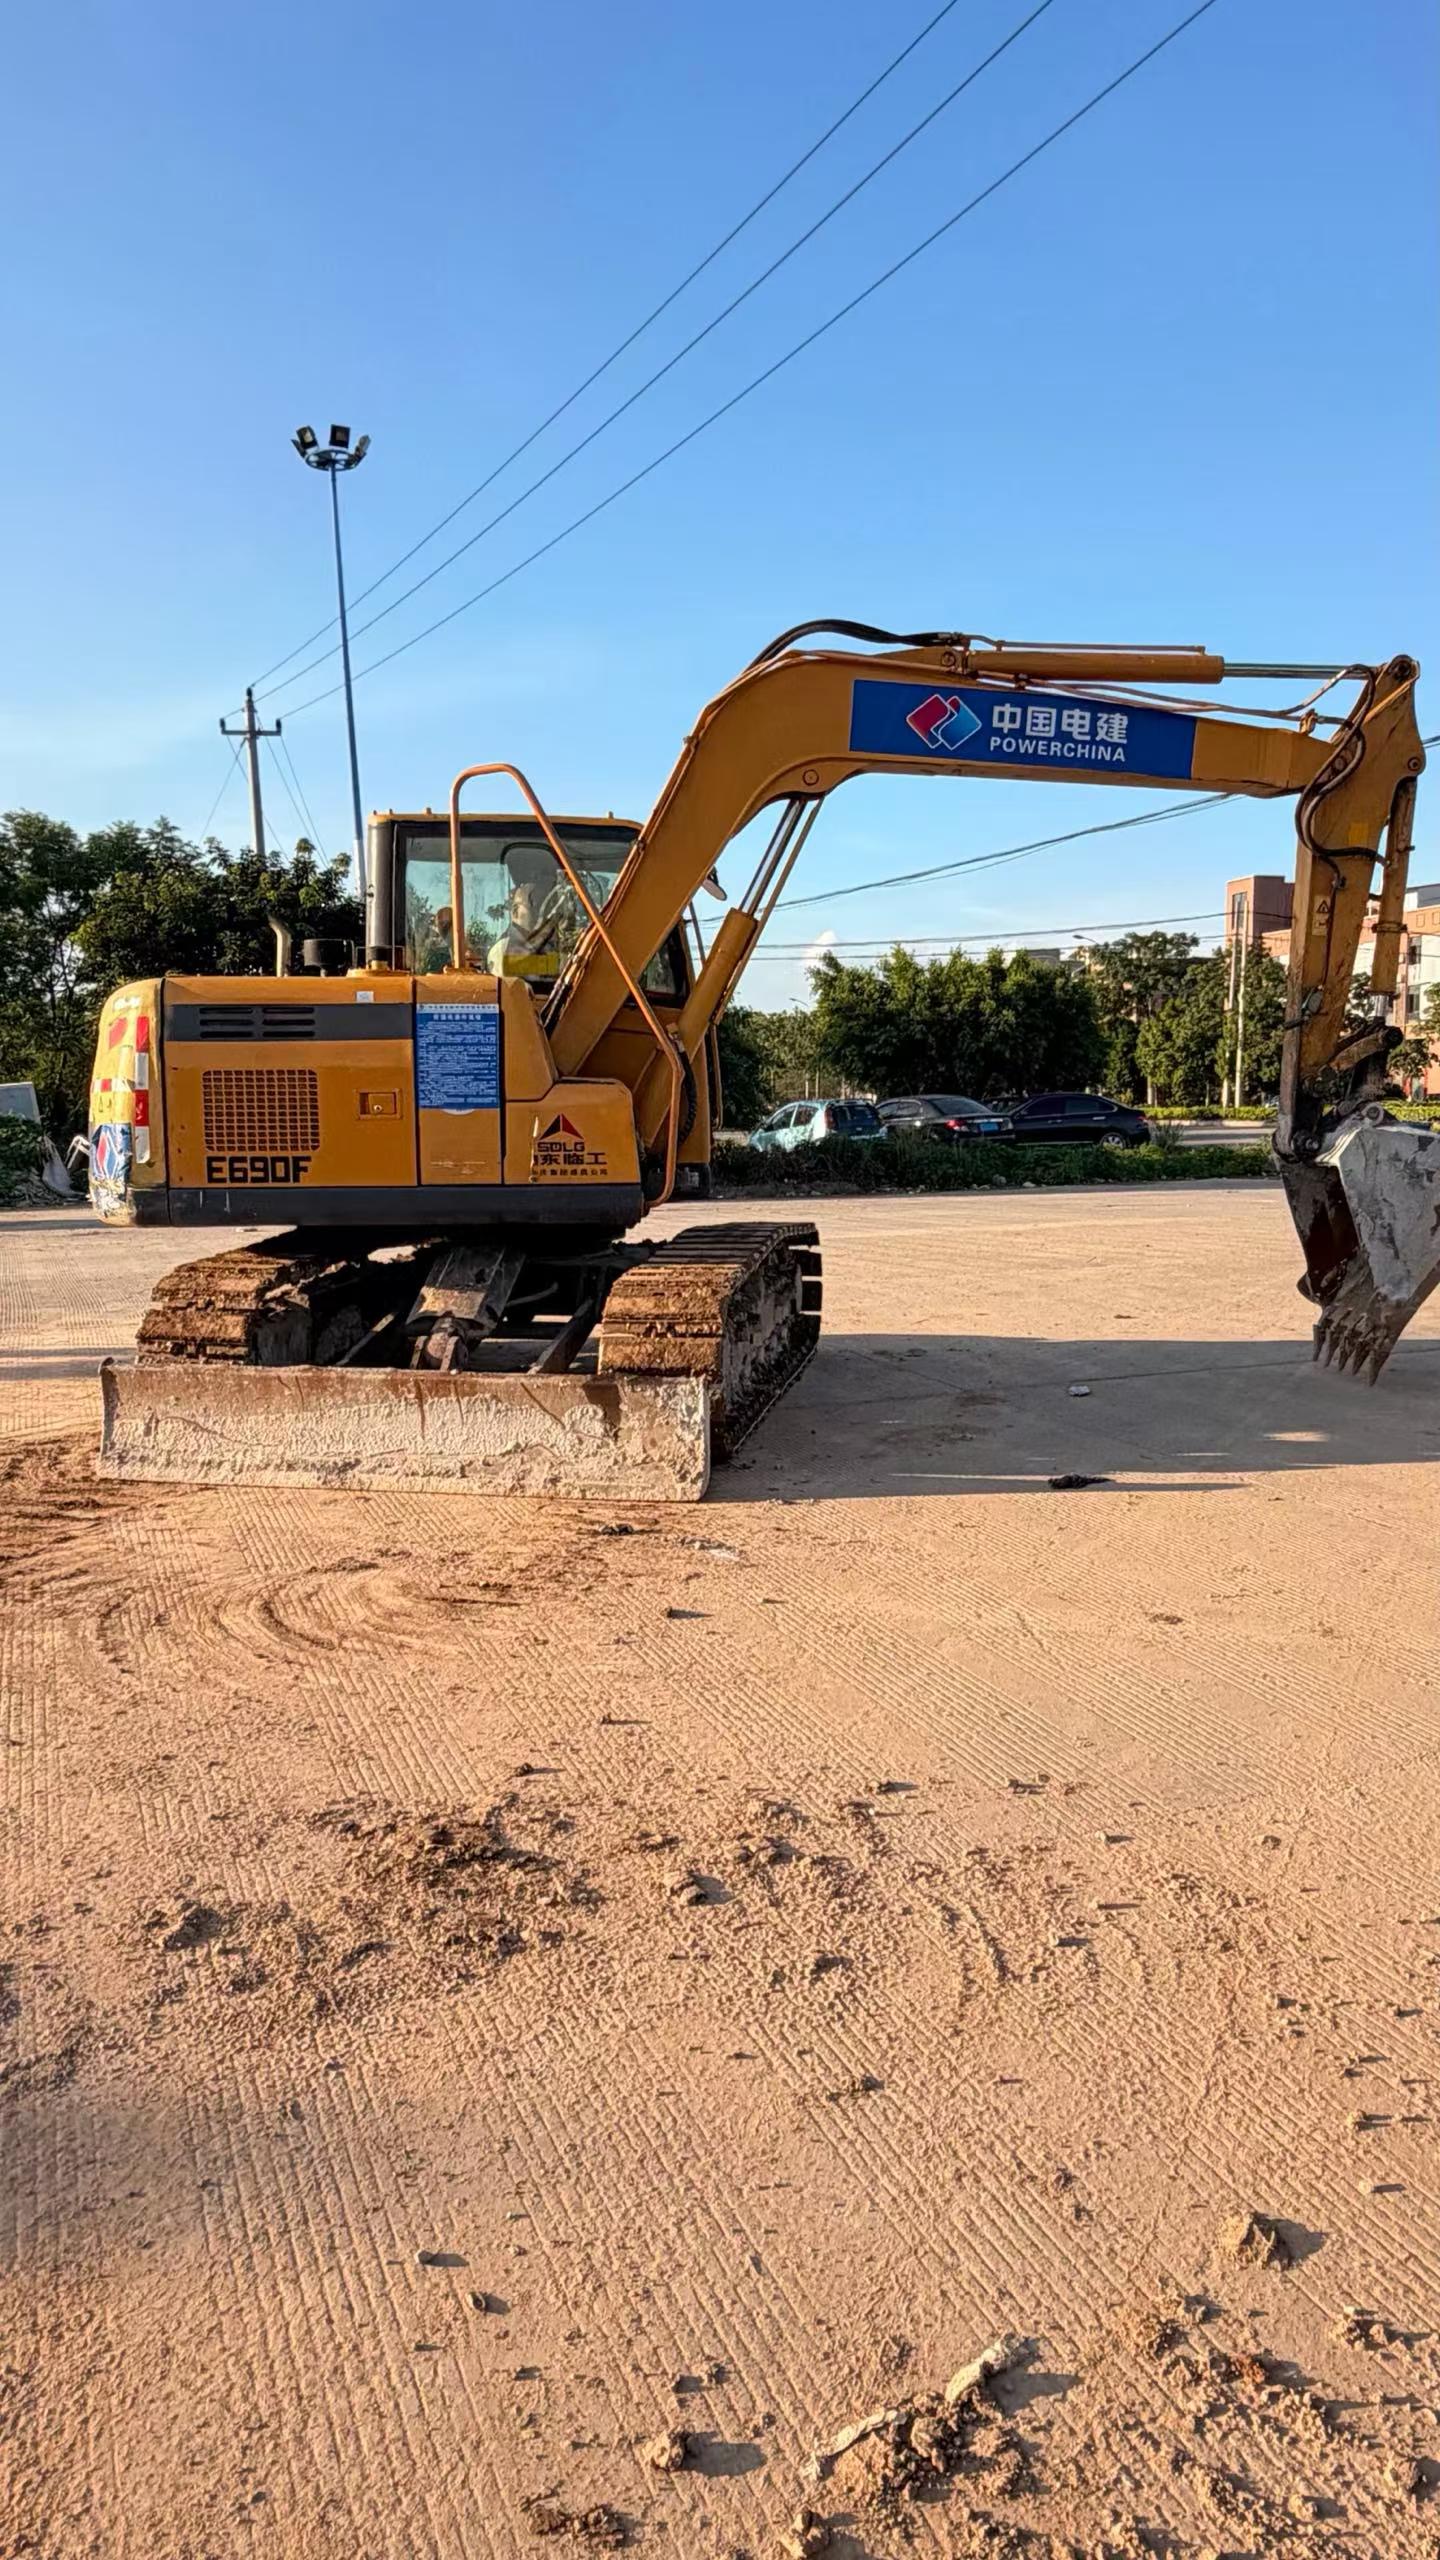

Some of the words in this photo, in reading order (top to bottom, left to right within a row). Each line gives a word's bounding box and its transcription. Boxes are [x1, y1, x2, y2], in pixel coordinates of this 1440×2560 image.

[991, 703, 1128, 744] 中国电建
[989, 736, 1126, 762] POWERCHINA
[537, 1142, 585, 1152] SDLG
[206, 1156, 312, 1183] E690F
